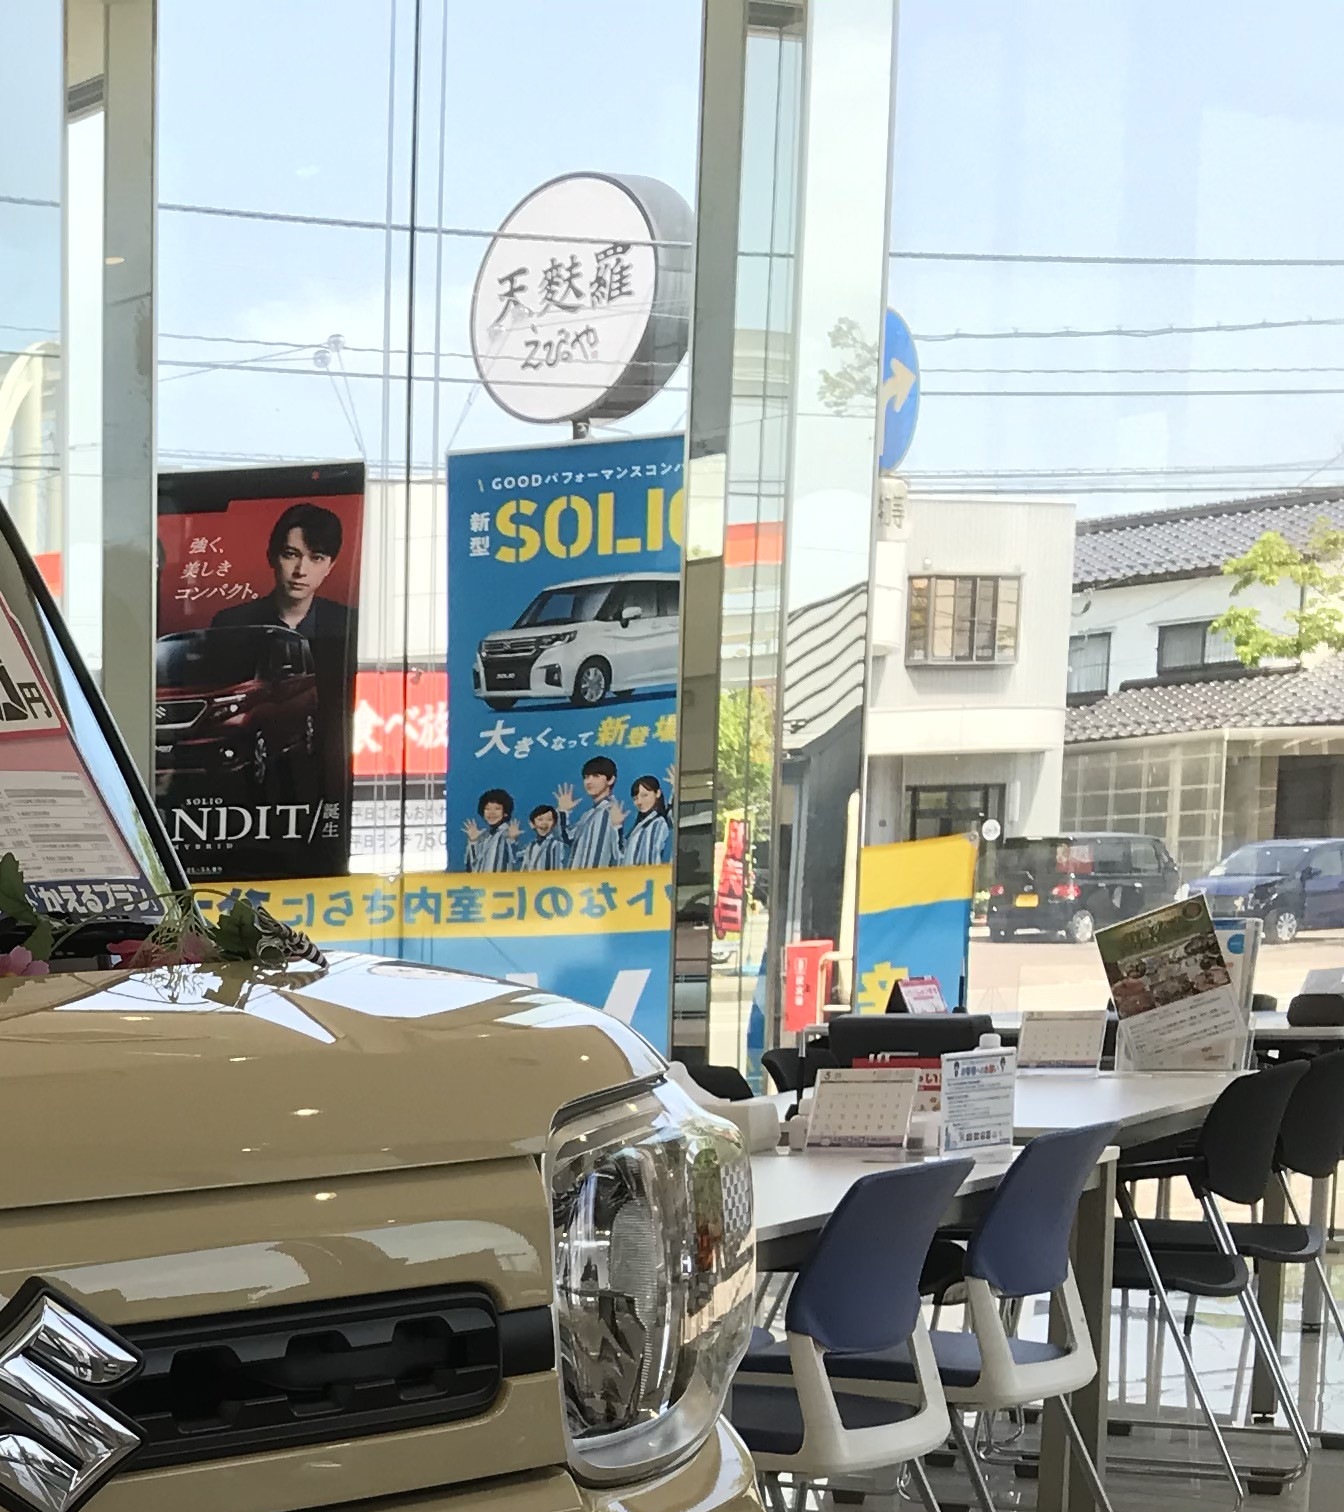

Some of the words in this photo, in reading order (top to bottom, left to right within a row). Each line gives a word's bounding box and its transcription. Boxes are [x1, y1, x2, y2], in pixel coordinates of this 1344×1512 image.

[188, 536, 224, 554] 強く、
[469, 512, 491, 557] 新型
[180, 560, 232, 579] 美しき
[321, 802, 340, 838] 誕生
